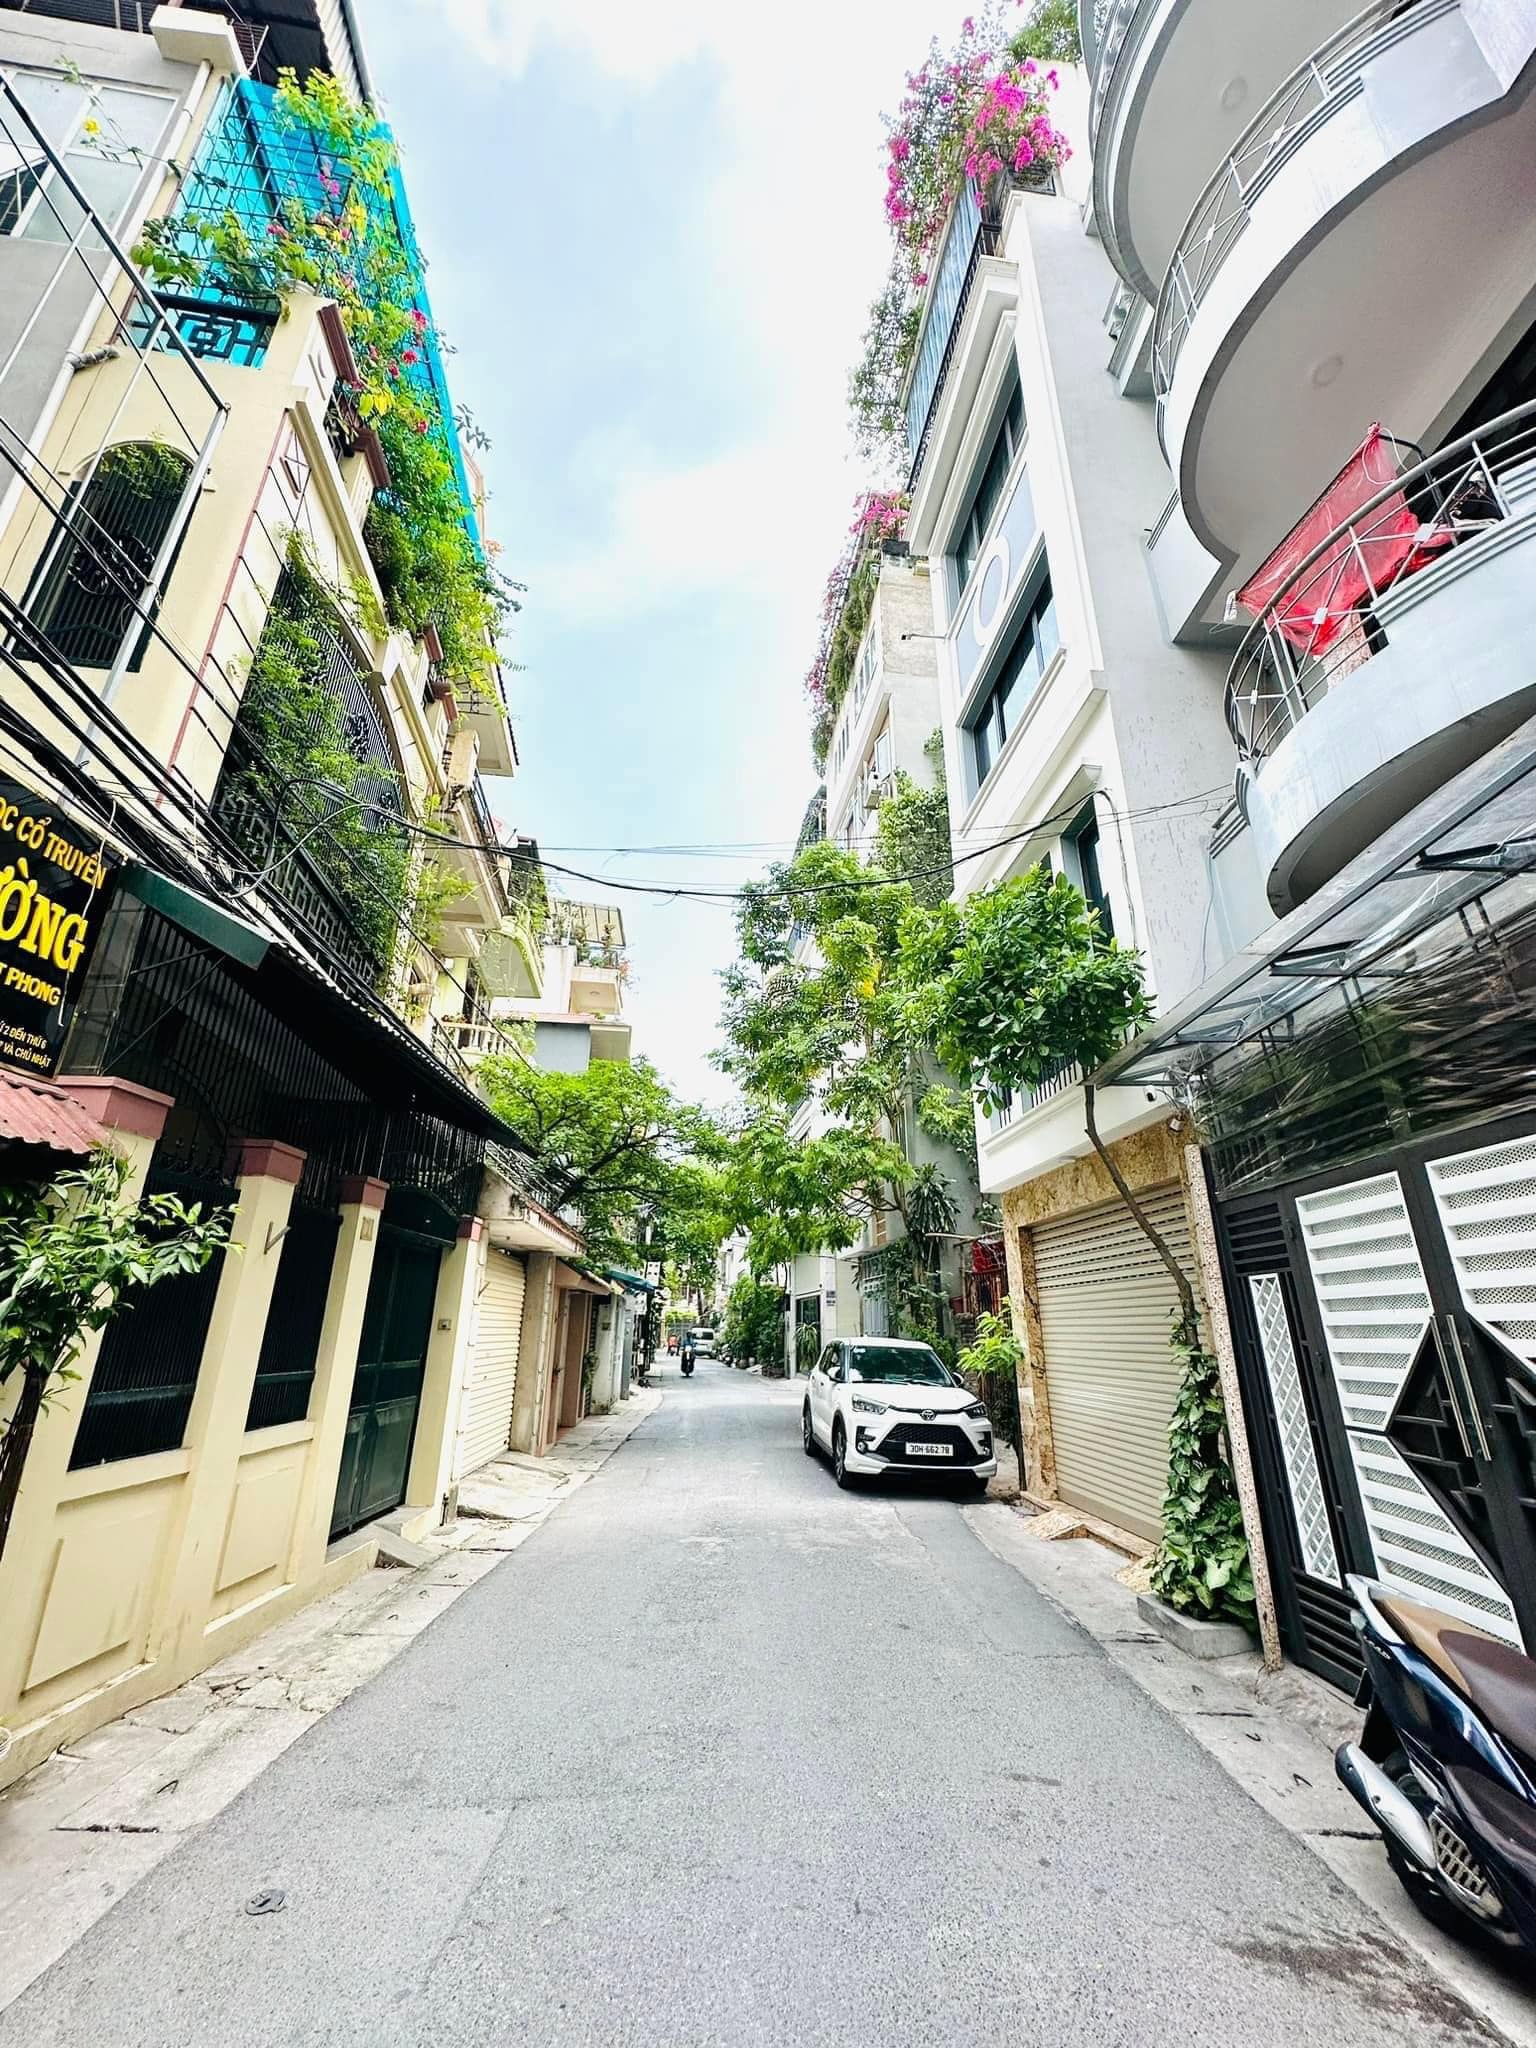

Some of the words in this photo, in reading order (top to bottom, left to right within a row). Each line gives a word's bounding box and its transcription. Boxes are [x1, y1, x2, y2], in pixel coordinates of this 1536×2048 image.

[17, 817, 52, 849] CỔ
[0, 857, 88, 973] ỜNG
[4, 967, 61, 1006] PHONG
